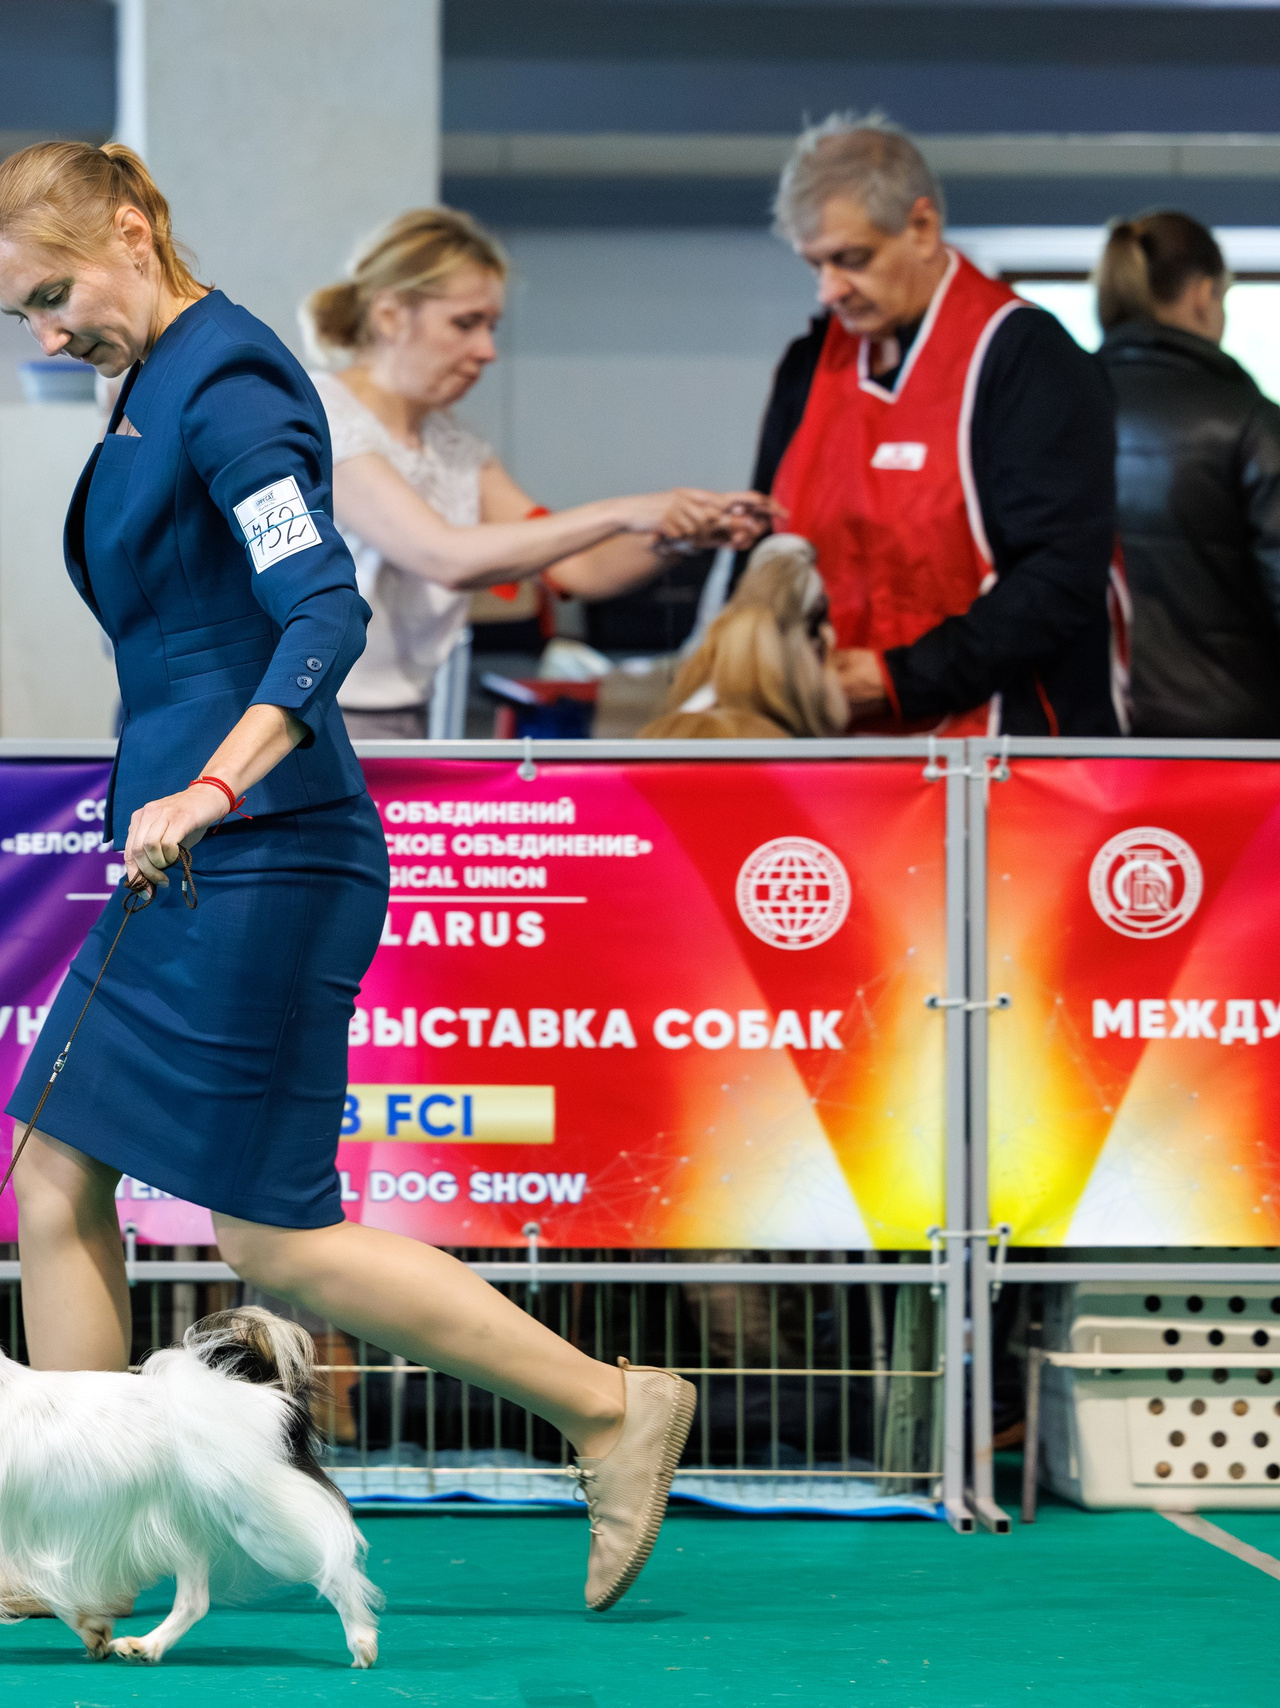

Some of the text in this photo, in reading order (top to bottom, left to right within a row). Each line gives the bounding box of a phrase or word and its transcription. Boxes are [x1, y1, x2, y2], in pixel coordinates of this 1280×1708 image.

[252, 506, 307, 555] 752
[385, 797, 575, 827] ОБЪЕДИНЕНИЙ
[451, 833, 653, 859] ОБЪЕДИНЕНИЕ»
[464, 866, 547, 889] UNION
[769, 885, 815, 902] FCI
[379, 910, 546, 947] LARUS
[348, 1007, 637, 1048] ВЫСТАВКА
[653, 1008, 845, 1050] СОБАК
[386, 1094, 473, 1137] FCI
[370, 1172, 458, 1203] DOG
[469, 1172, 587, 1204] SHOW
